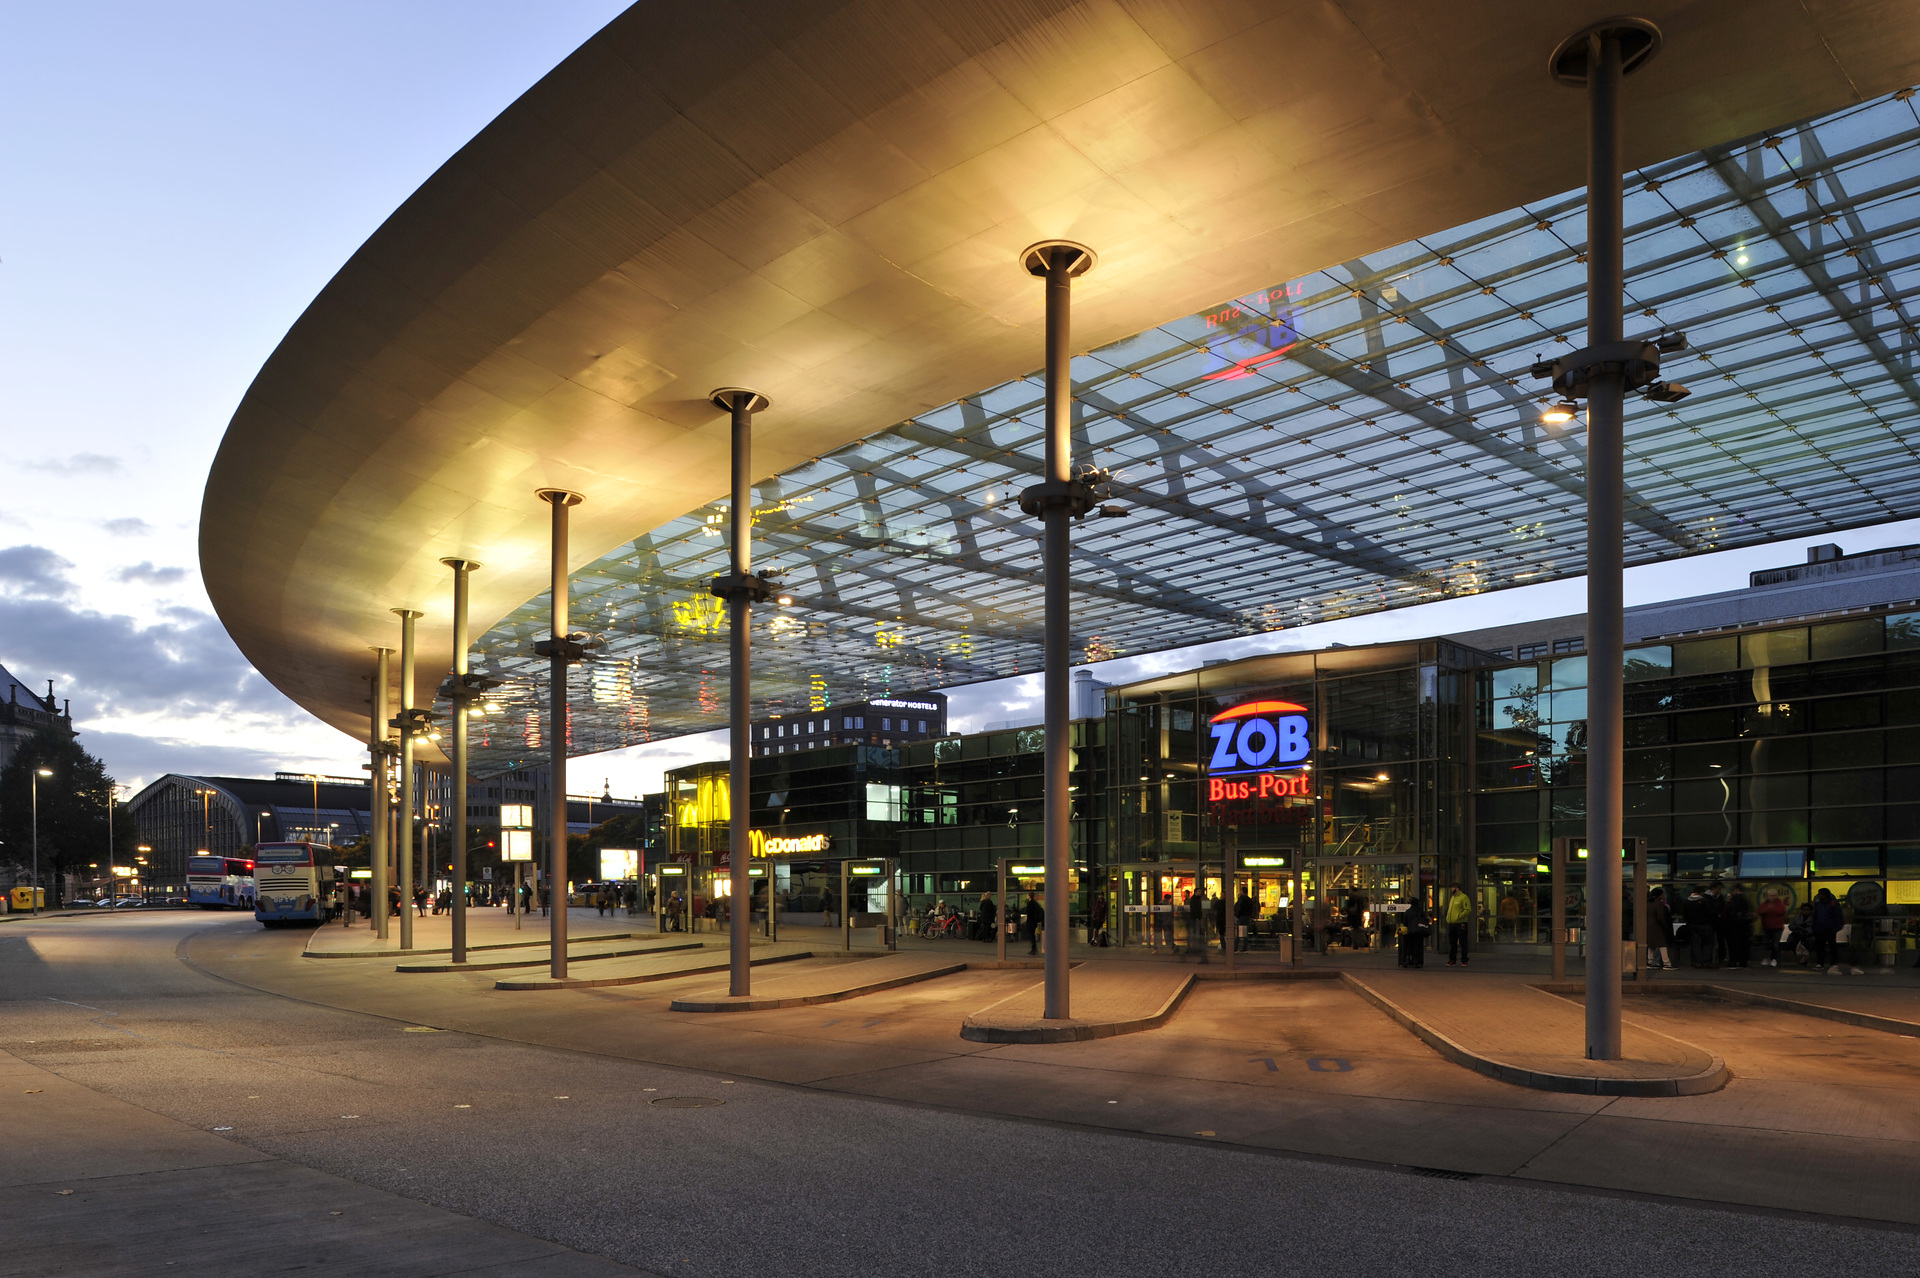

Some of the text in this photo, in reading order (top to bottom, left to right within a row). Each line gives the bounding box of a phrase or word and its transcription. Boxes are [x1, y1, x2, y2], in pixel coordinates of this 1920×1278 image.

[907, 701, 938, 711] HOSTELS
[1209, 715, 1310, 769] ZOB
[1209, 773, 1310, 801] Bus-Port
[1210, 802, 1309, 826] Hamburg
[1247, 1058, 1354, 1072] 10
